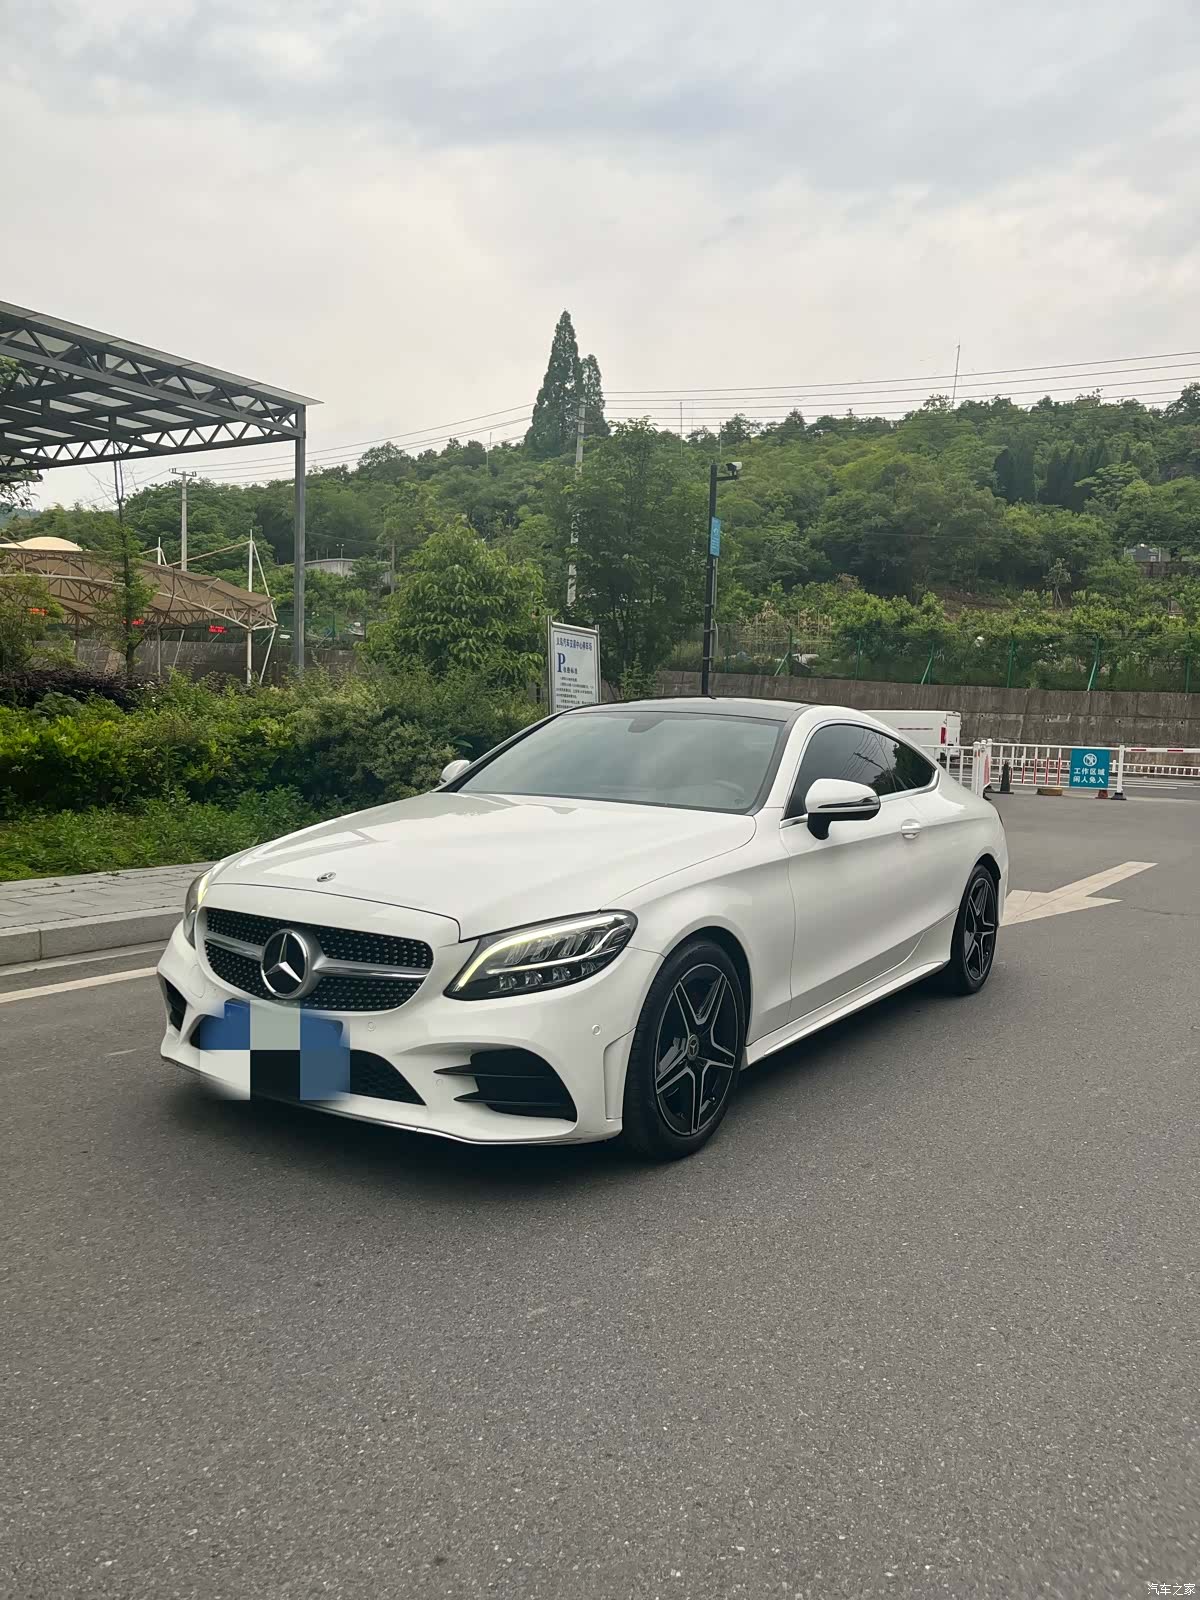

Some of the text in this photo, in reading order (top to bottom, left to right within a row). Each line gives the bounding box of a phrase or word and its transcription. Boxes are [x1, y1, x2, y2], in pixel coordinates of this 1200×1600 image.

[557, 653, 566, 672] P
[1072, 775, 1105, 784] 闲人免入
